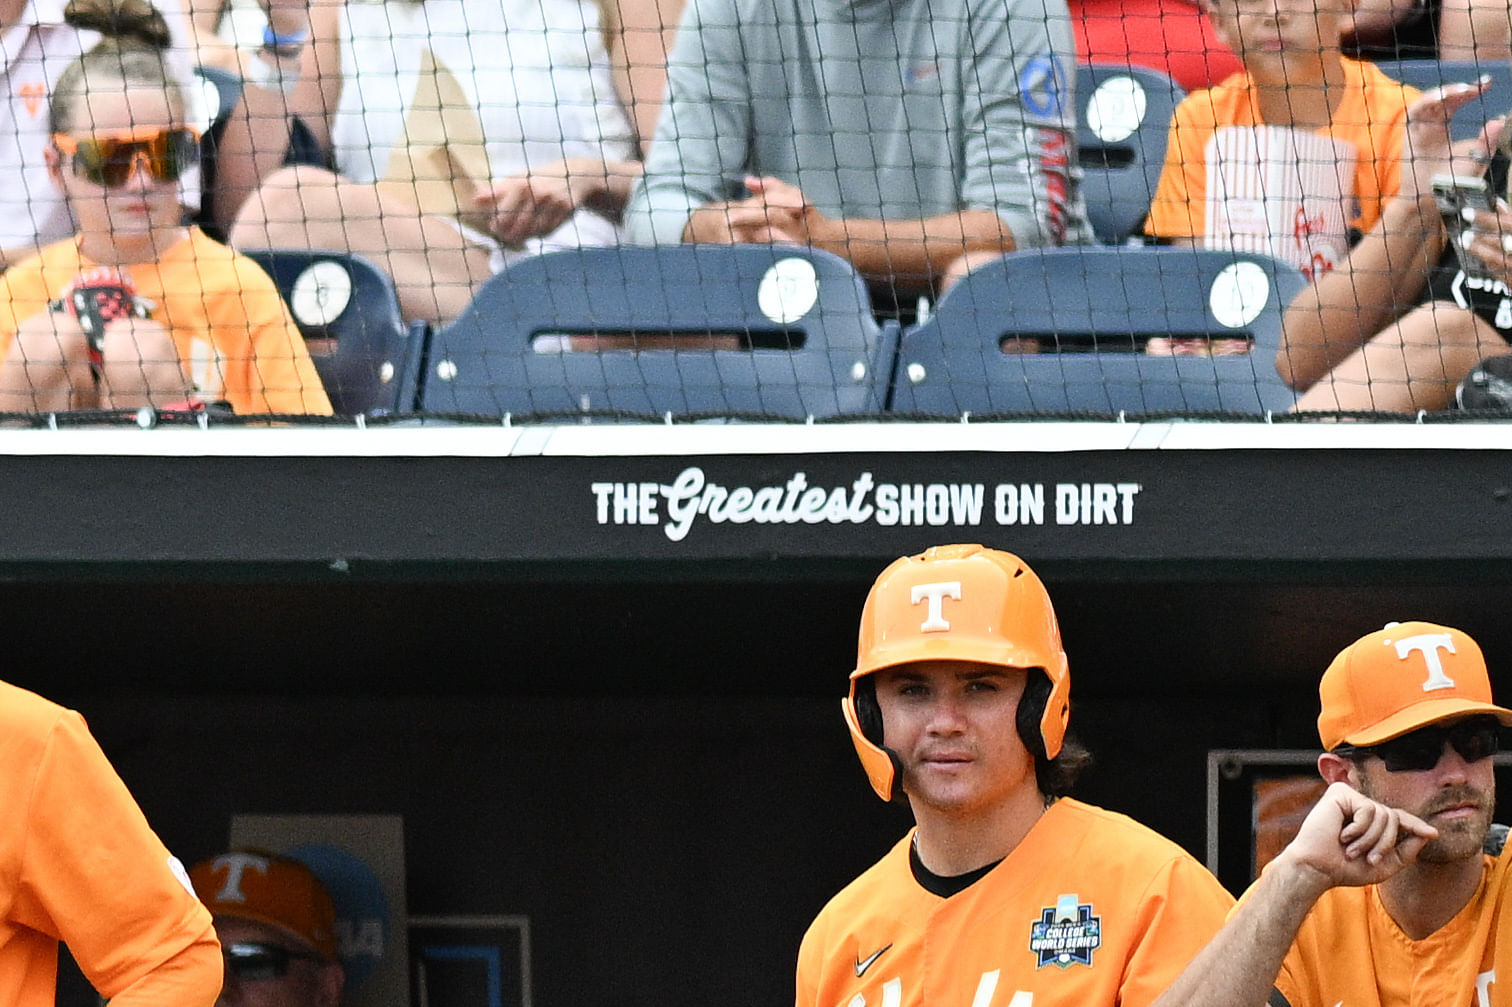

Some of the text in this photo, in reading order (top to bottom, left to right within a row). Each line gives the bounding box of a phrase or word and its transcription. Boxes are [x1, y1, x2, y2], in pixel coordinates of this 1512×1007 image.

[591, 466, 1140, 541] THE Greatest SHOW ON DIRT
[911, 581, 962, 634] T
[1394, 633, 1456, 692] T
[211, 852, 270, 903] T
[1032, 936, 1098, 949] WORLD SERIES
